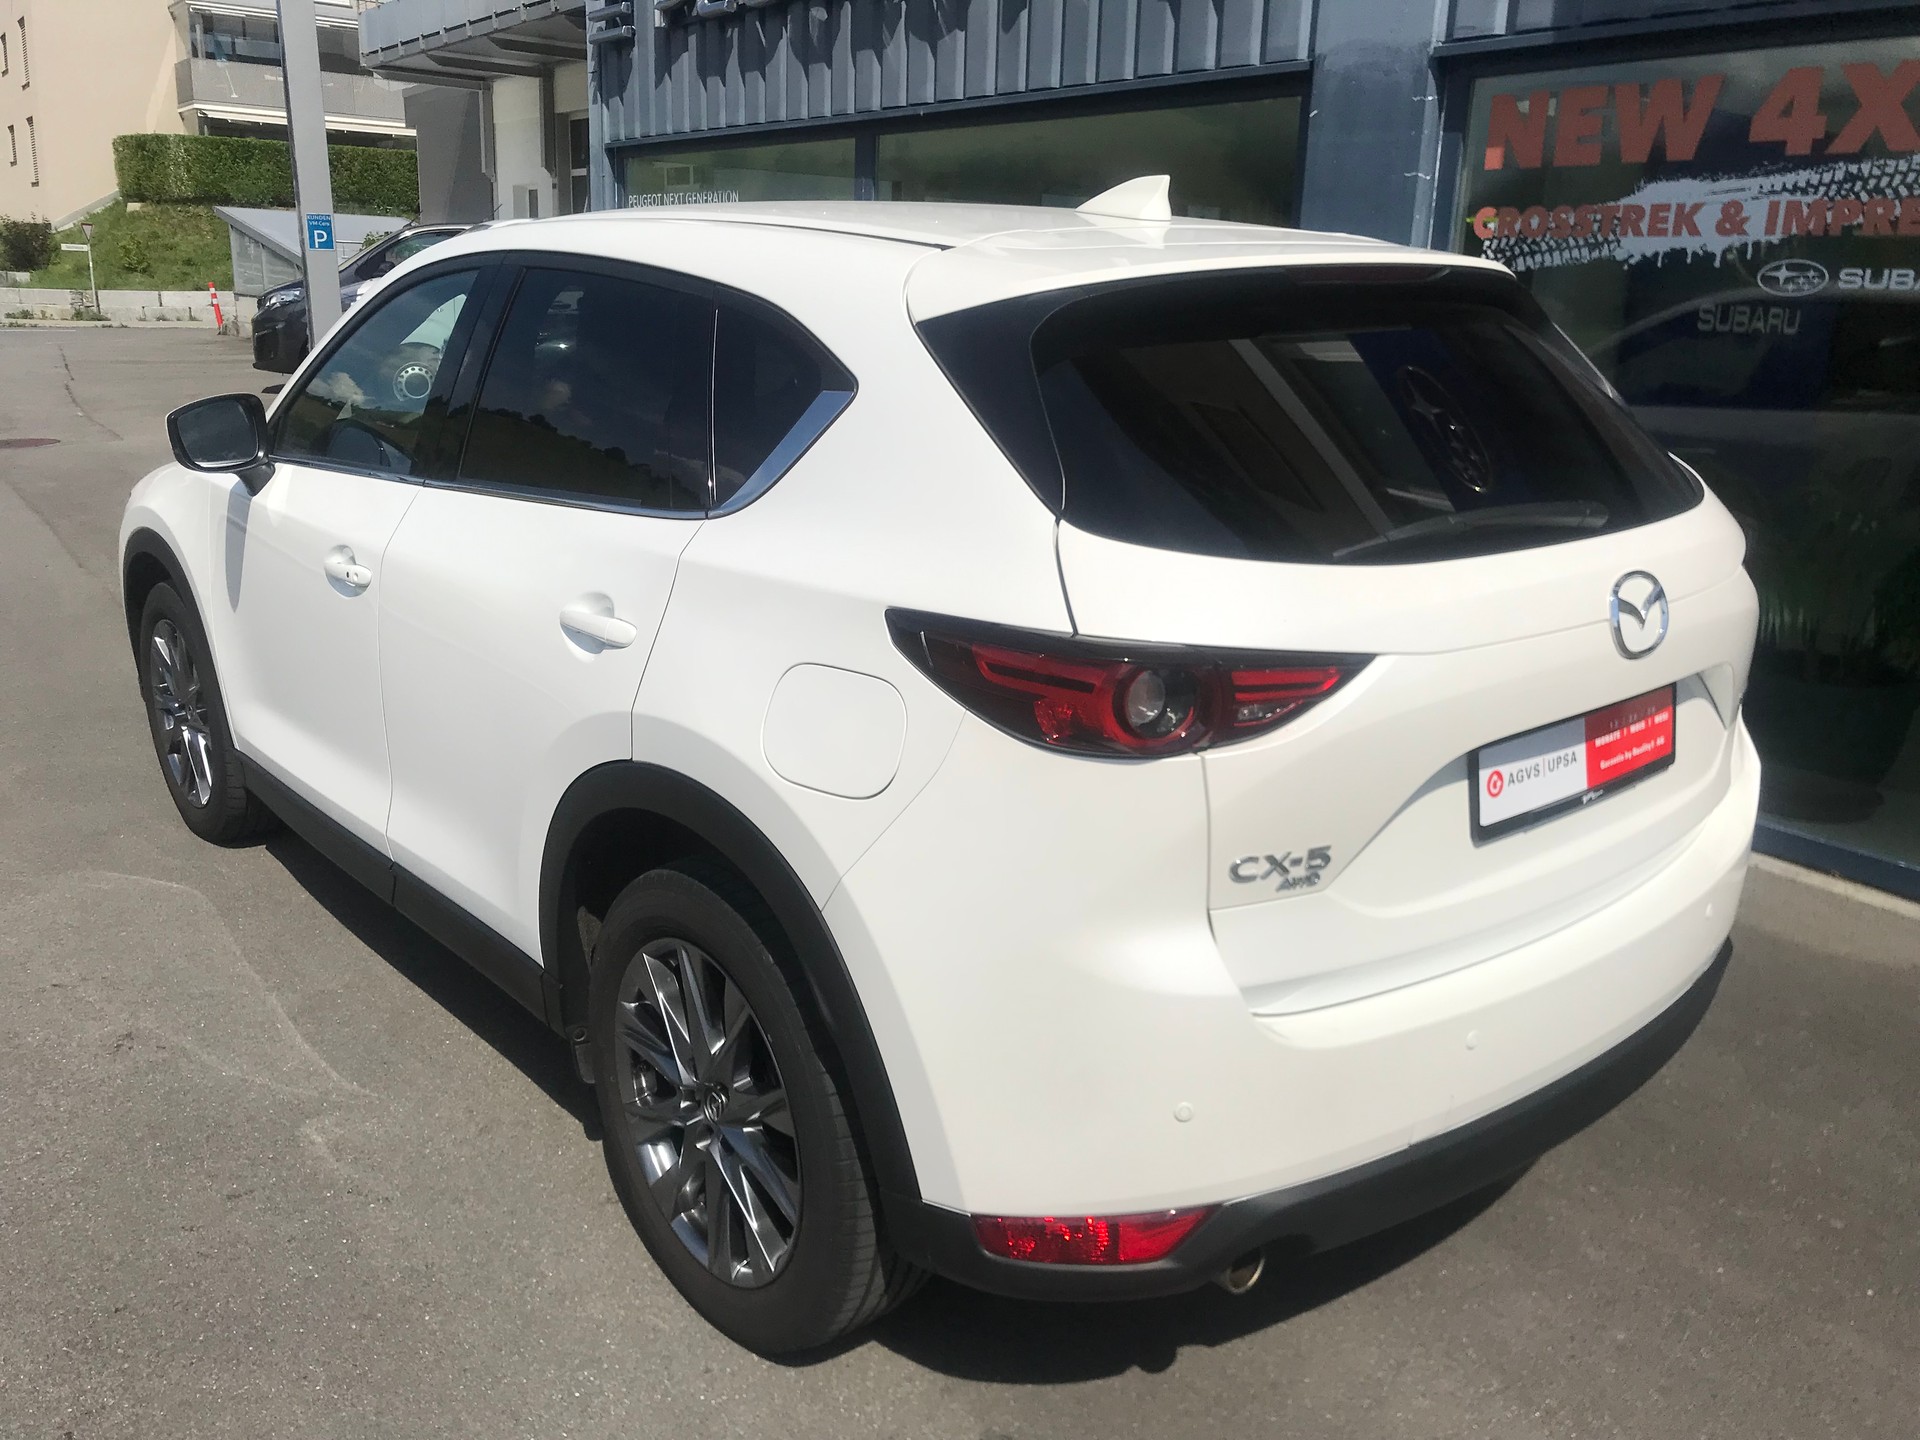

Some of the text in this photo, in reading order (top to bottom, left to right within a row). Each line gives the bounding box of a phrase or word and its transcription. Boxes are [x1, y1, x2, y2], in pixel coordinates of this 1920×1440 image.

[1484, 74, 1727, 171] NEW
[628, 190, 739, 208] PEUGEOT NEXT GENERATION
[1473, 203, 1706, 239] CROSSTREK
[1715, 202, 1750, 237] &
[313, 229, 328, 249] P
[1697, 303, 1801, 335] SUBARU
[1507, 751, 1577, 787] AGVS UPSA
[1228, 845, 1332, 884] CX-5
